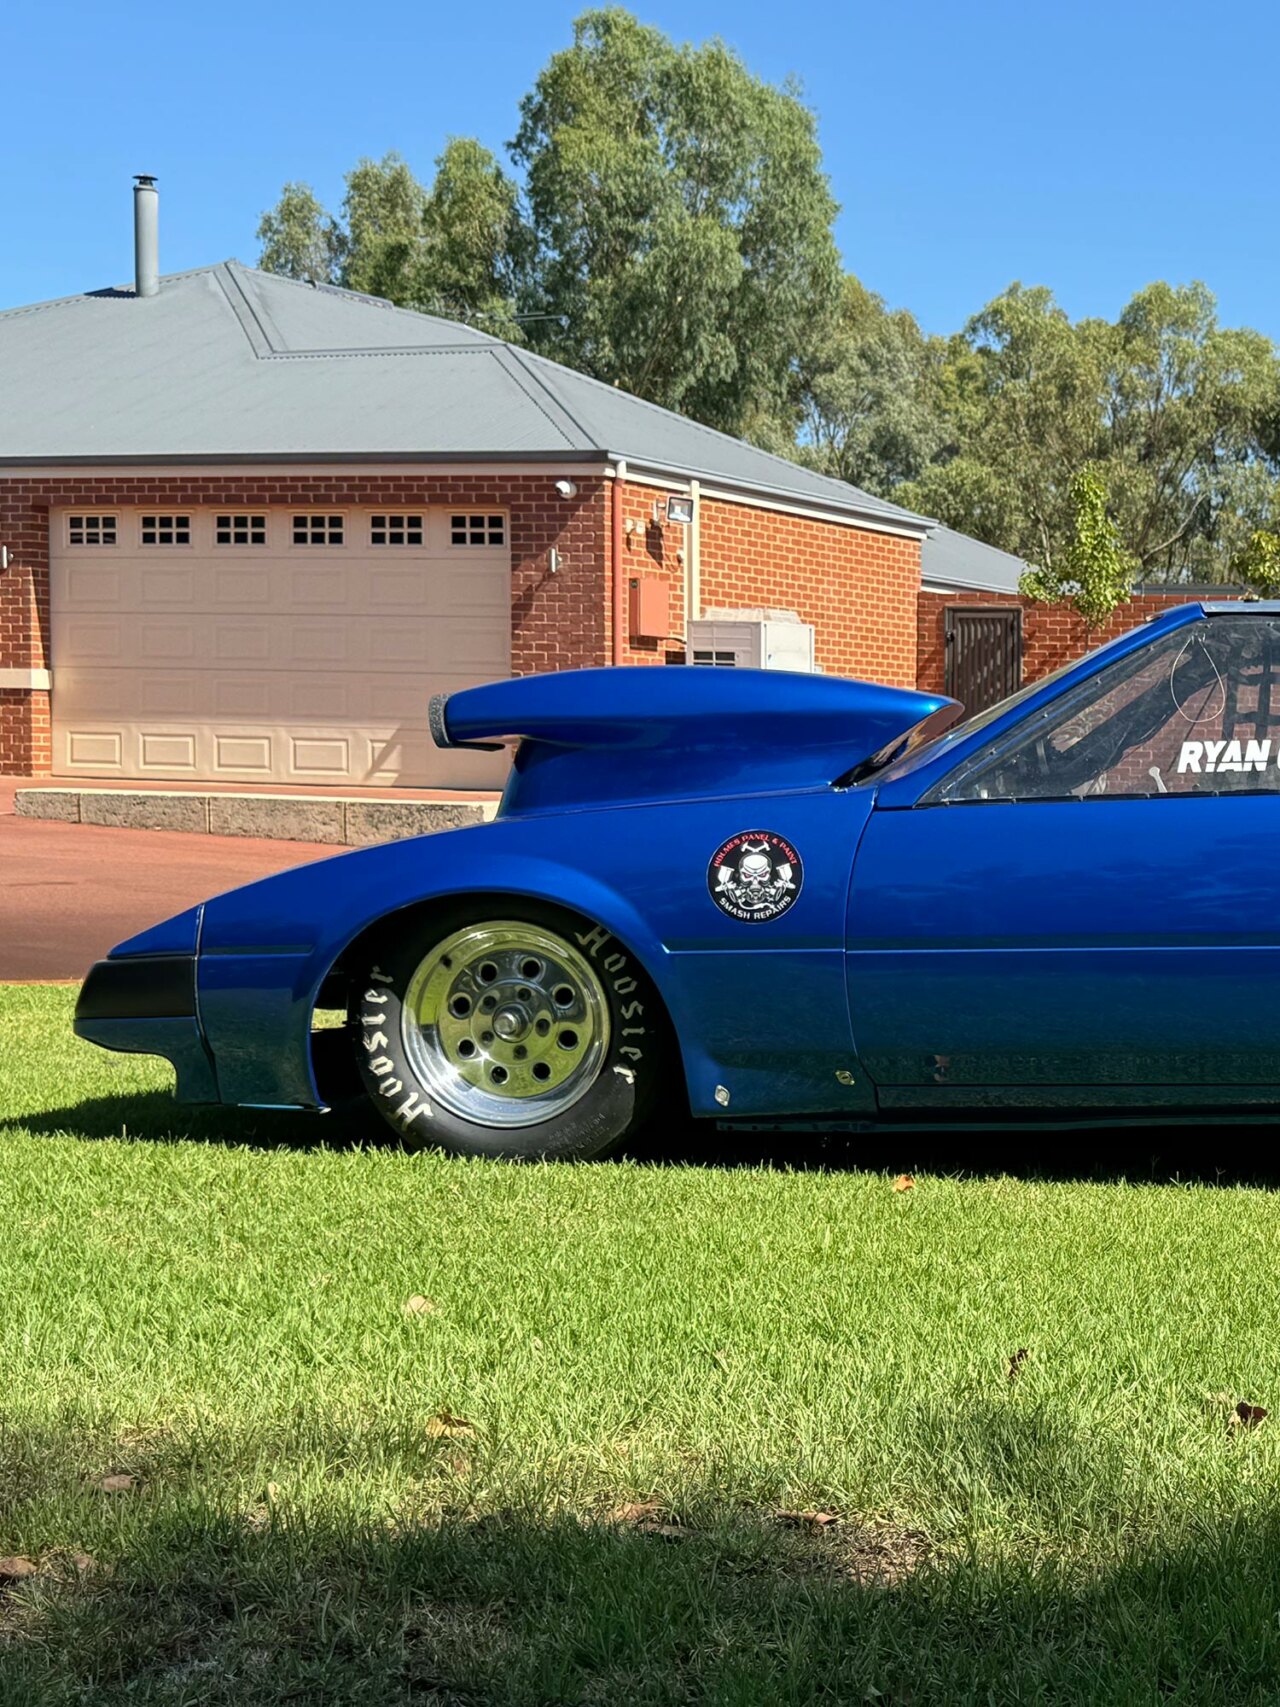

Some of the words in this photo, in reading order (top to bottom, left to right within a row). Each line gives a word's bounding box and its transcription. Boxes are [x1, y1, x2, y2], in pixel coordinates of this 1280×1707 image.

[1177, 740, 1272, 774] RYAN
[741, 833, 770, 842] PANEL
[779, 842, 797, 864] PAINT
[719, 897, 751, 919] SMASH
[753, 895, 791, 920] REPAIRS
[574, 926, 645, 1085] Hoosier
[362, 966, 434, 1132] Hoosier
